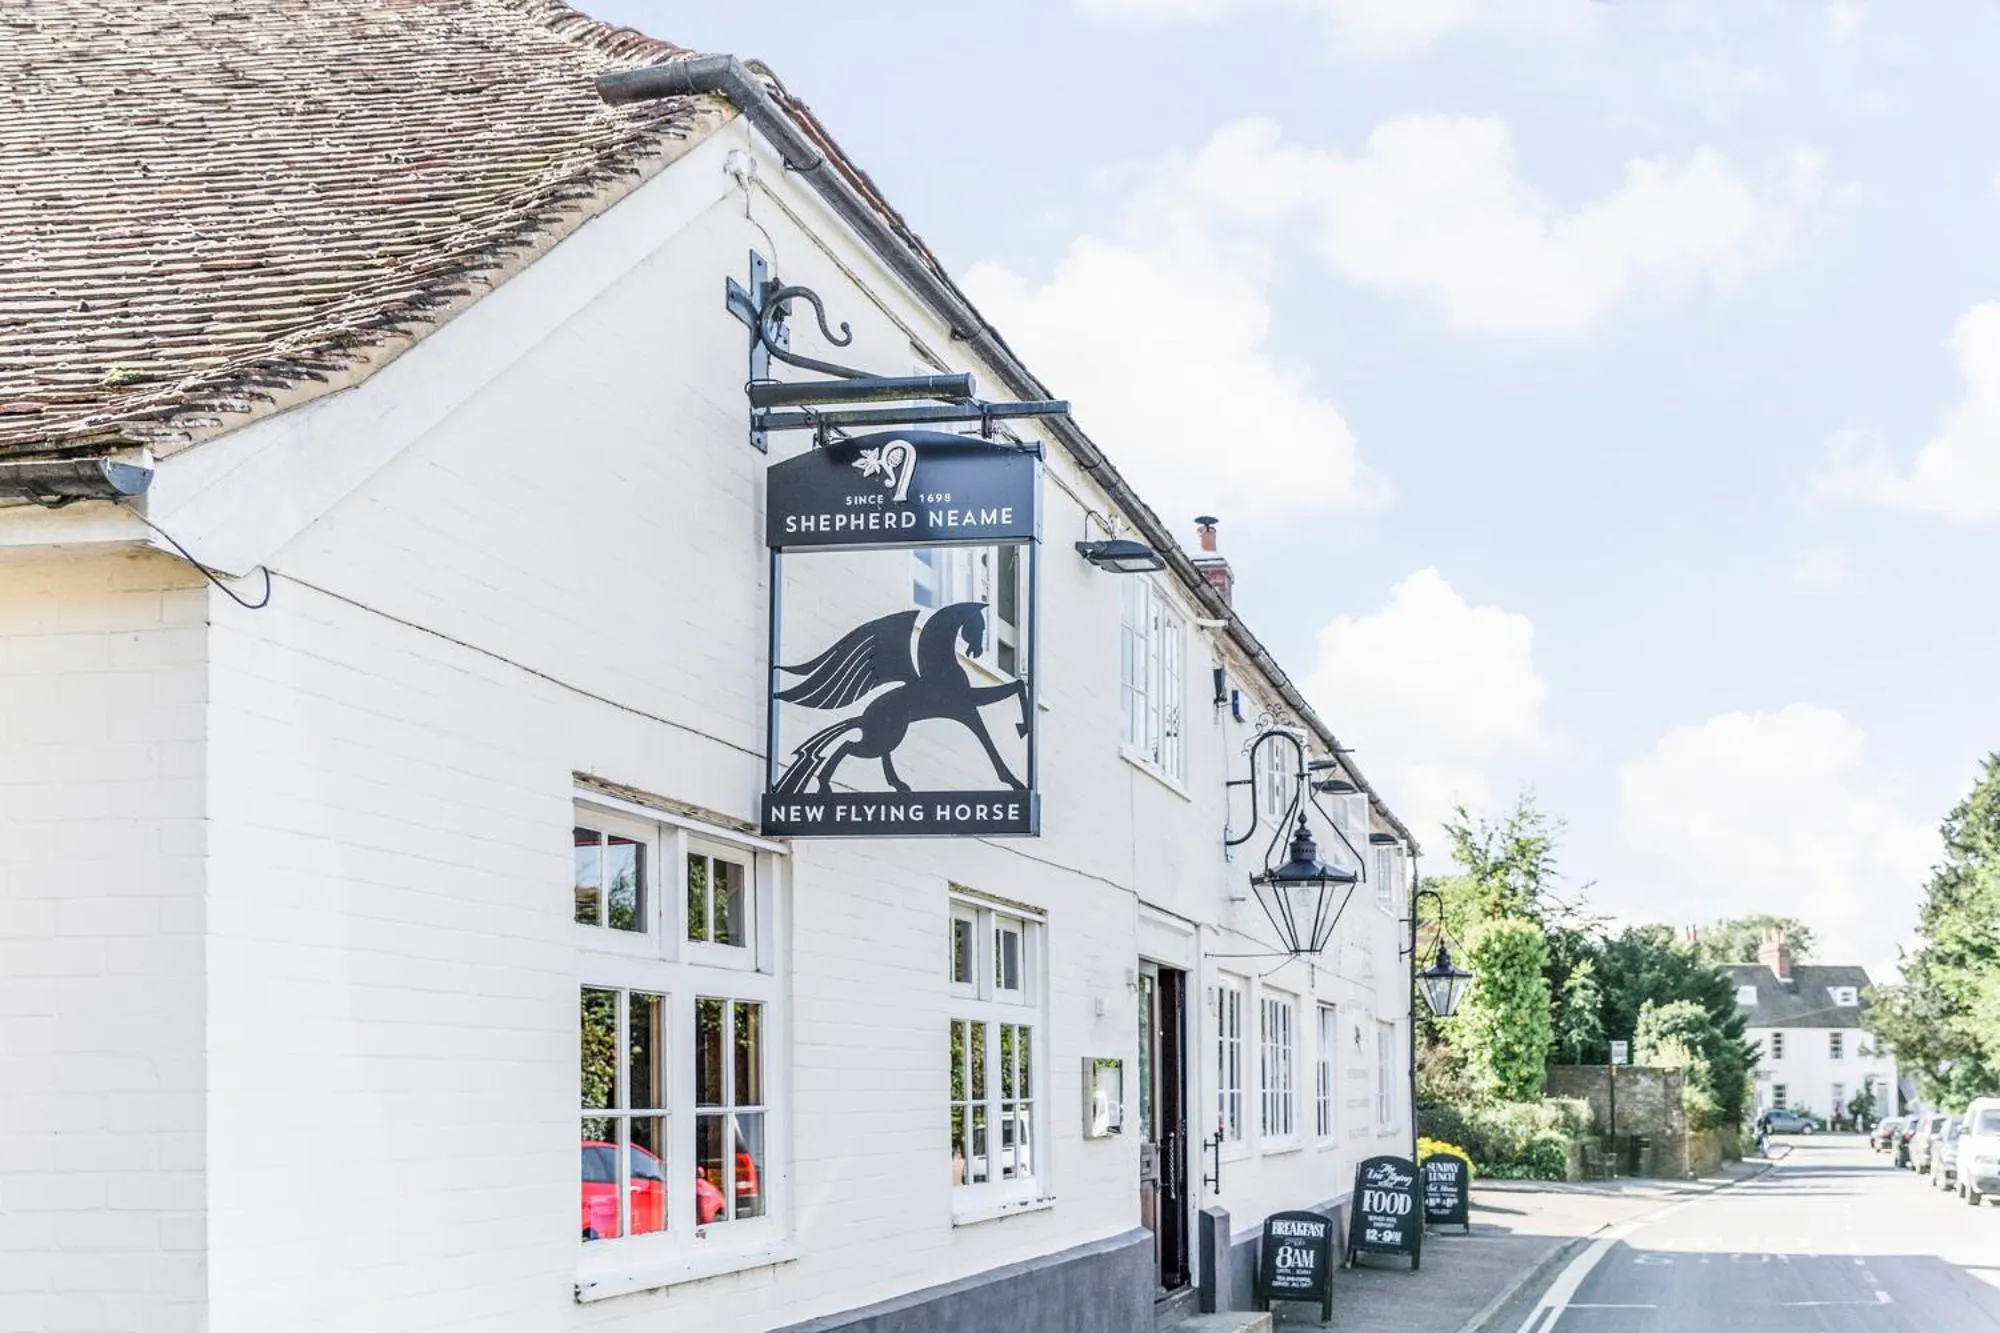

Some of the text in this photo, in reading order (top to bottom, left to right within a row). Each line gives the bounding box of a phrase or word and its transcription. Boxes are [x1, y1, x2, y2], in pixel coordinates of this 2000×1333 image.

[846, 493, 952, 506] SINCE 1698
[785, 507, 1013, 533] SHEPHERD NEAME
[771, 803, 1020, 822] NEW FLYING HORSE
[1426, 1162, 1460, 1173] SUNDAY
[1428, 1172, 1456, 1182] LUNCH
[1362, 1190, 1412, 1215] FOOD
[1271, 1221, 1325, 1237] BREAKFAST
[1275, 1246, 1315, 1268] 8AM
